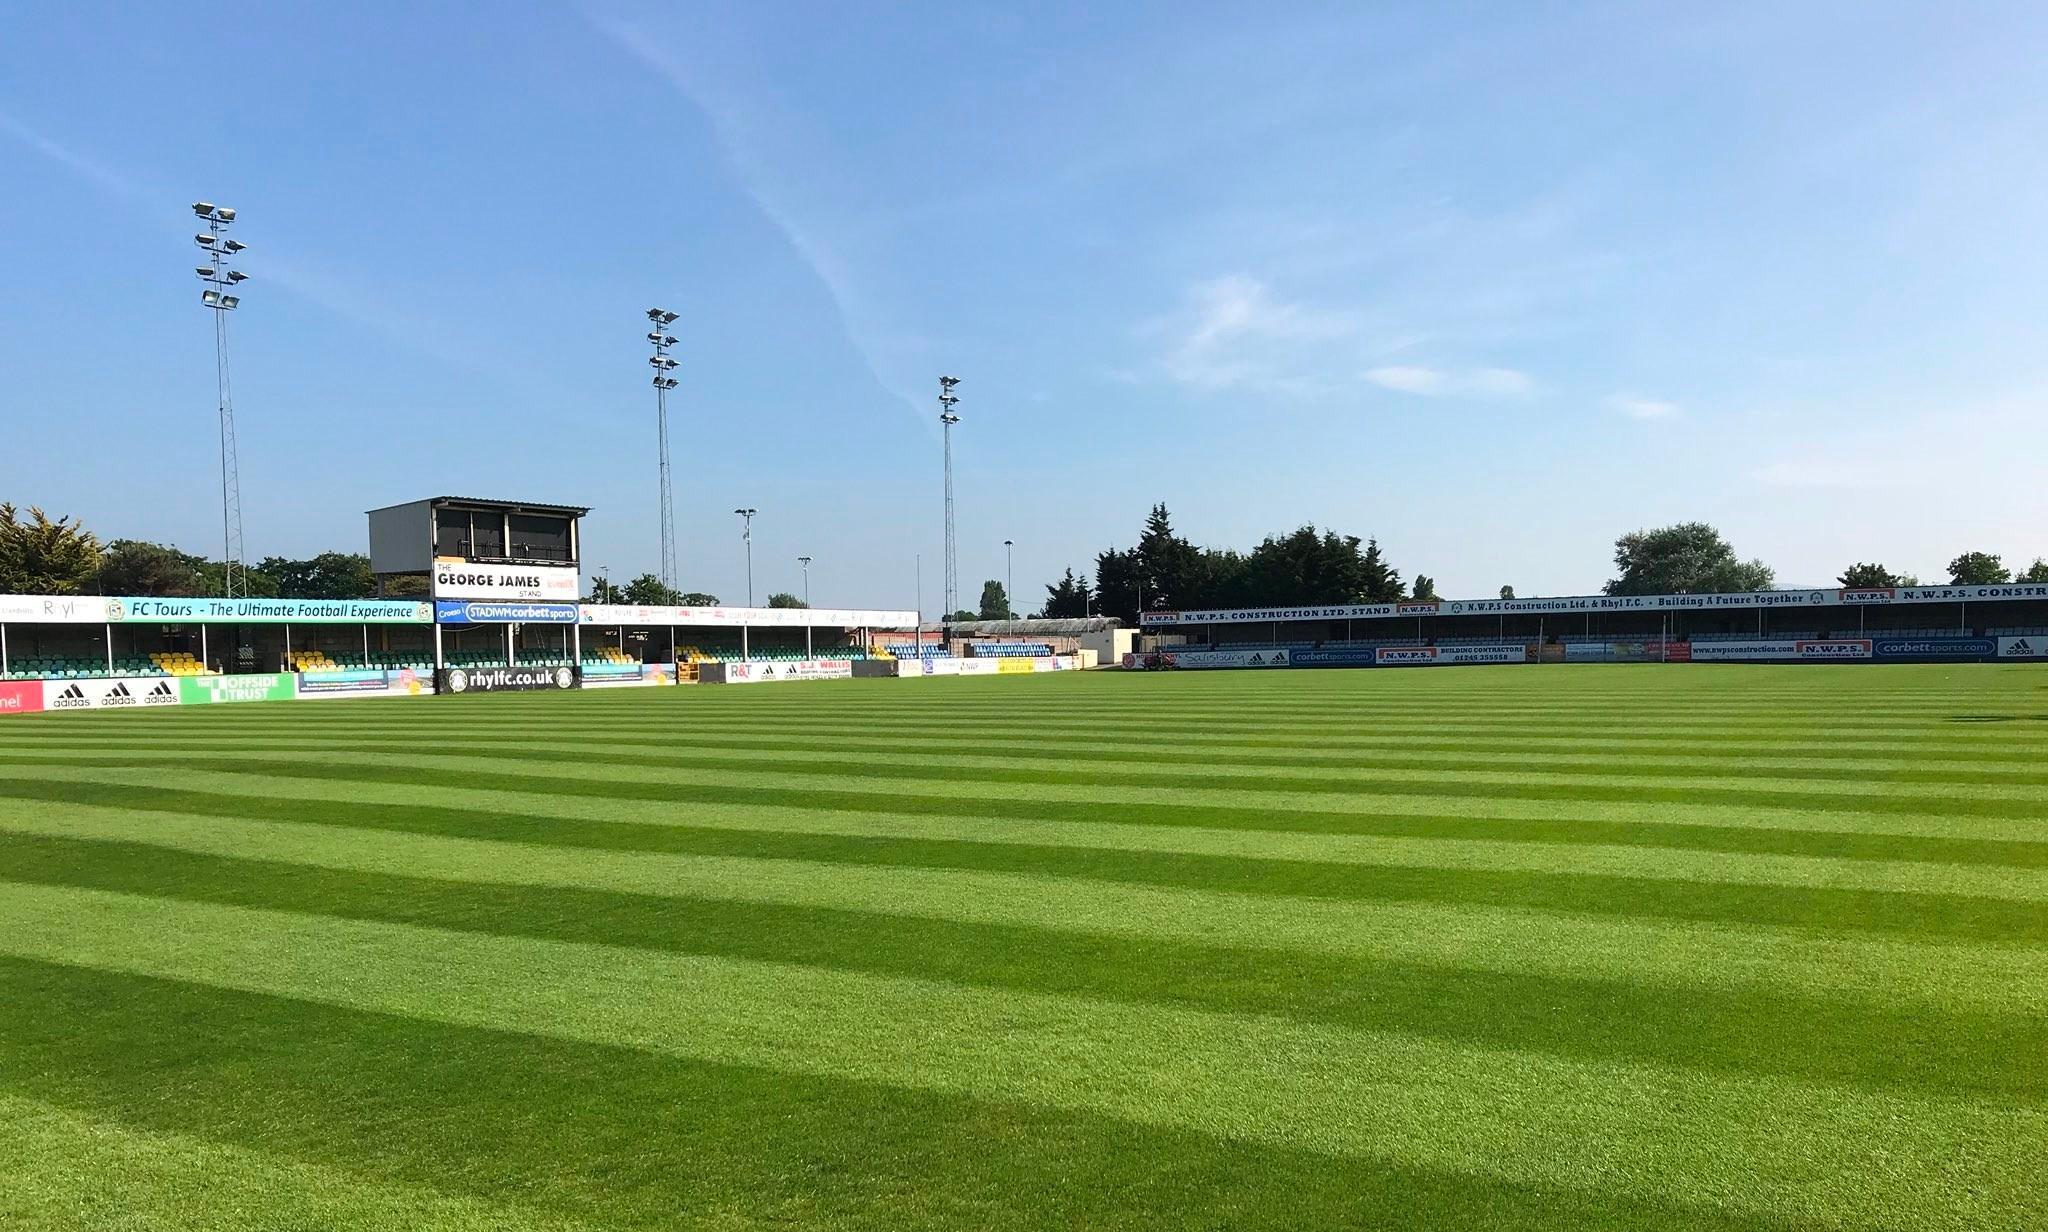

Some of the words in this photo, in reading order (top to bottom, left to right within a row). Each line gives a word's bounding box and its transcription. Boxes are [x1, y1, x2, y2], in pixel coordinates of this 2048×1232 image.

[437, 564, 452, 572] THE
[438, 573, 494, 586] GEORGE
[499, 575, 540, 588] JAMES
[519, 590, 542, 598] STAND
[1904, 590, 1972, 599] N.W.P.S.
[1977, 587, 2048, 597] CONSTR
[1504, 601, 1567, 610] Construction
[1570, 600, 1589, 608] Ltd.
[1601, 599, 1623, 609] Rhyl
[1625, 598, 1643, 607] F.C.
[1658, 597, 1703, 607] Building
[1706, 596, 1713, 605] A
[1716, 595, 1751, 605] Future
[1754, 594, 1804, 604] Together
[132, 602, 150, 616] FC
[154, 602, 192, 616] Tours
[209, 602, 233, 616] The
[238, 602, 294, 616] Ultimate
[298, 603, 348, 617] Football
[351, 604, 413, 619] Experience
[1185, 613, 1228, 621] N.W.P.S.
[1231, 610, 1319, 619] CONSTRUCTION
[1351, 607, 1390, 615] STAND
[1805, 645, 1862, 653] N.W.P.S.
[820, 660, 850, 669] WALLIS
[731, 664, 752, 678] R&T
[469, 669, 554, 690] rhylfc.co.uk
[144, 693, 178, 704] adidas
[227, 687, 269, 700] TRUST
[53, 697, 90, 708] adidas
[102, 694, 137, 706] adidas
